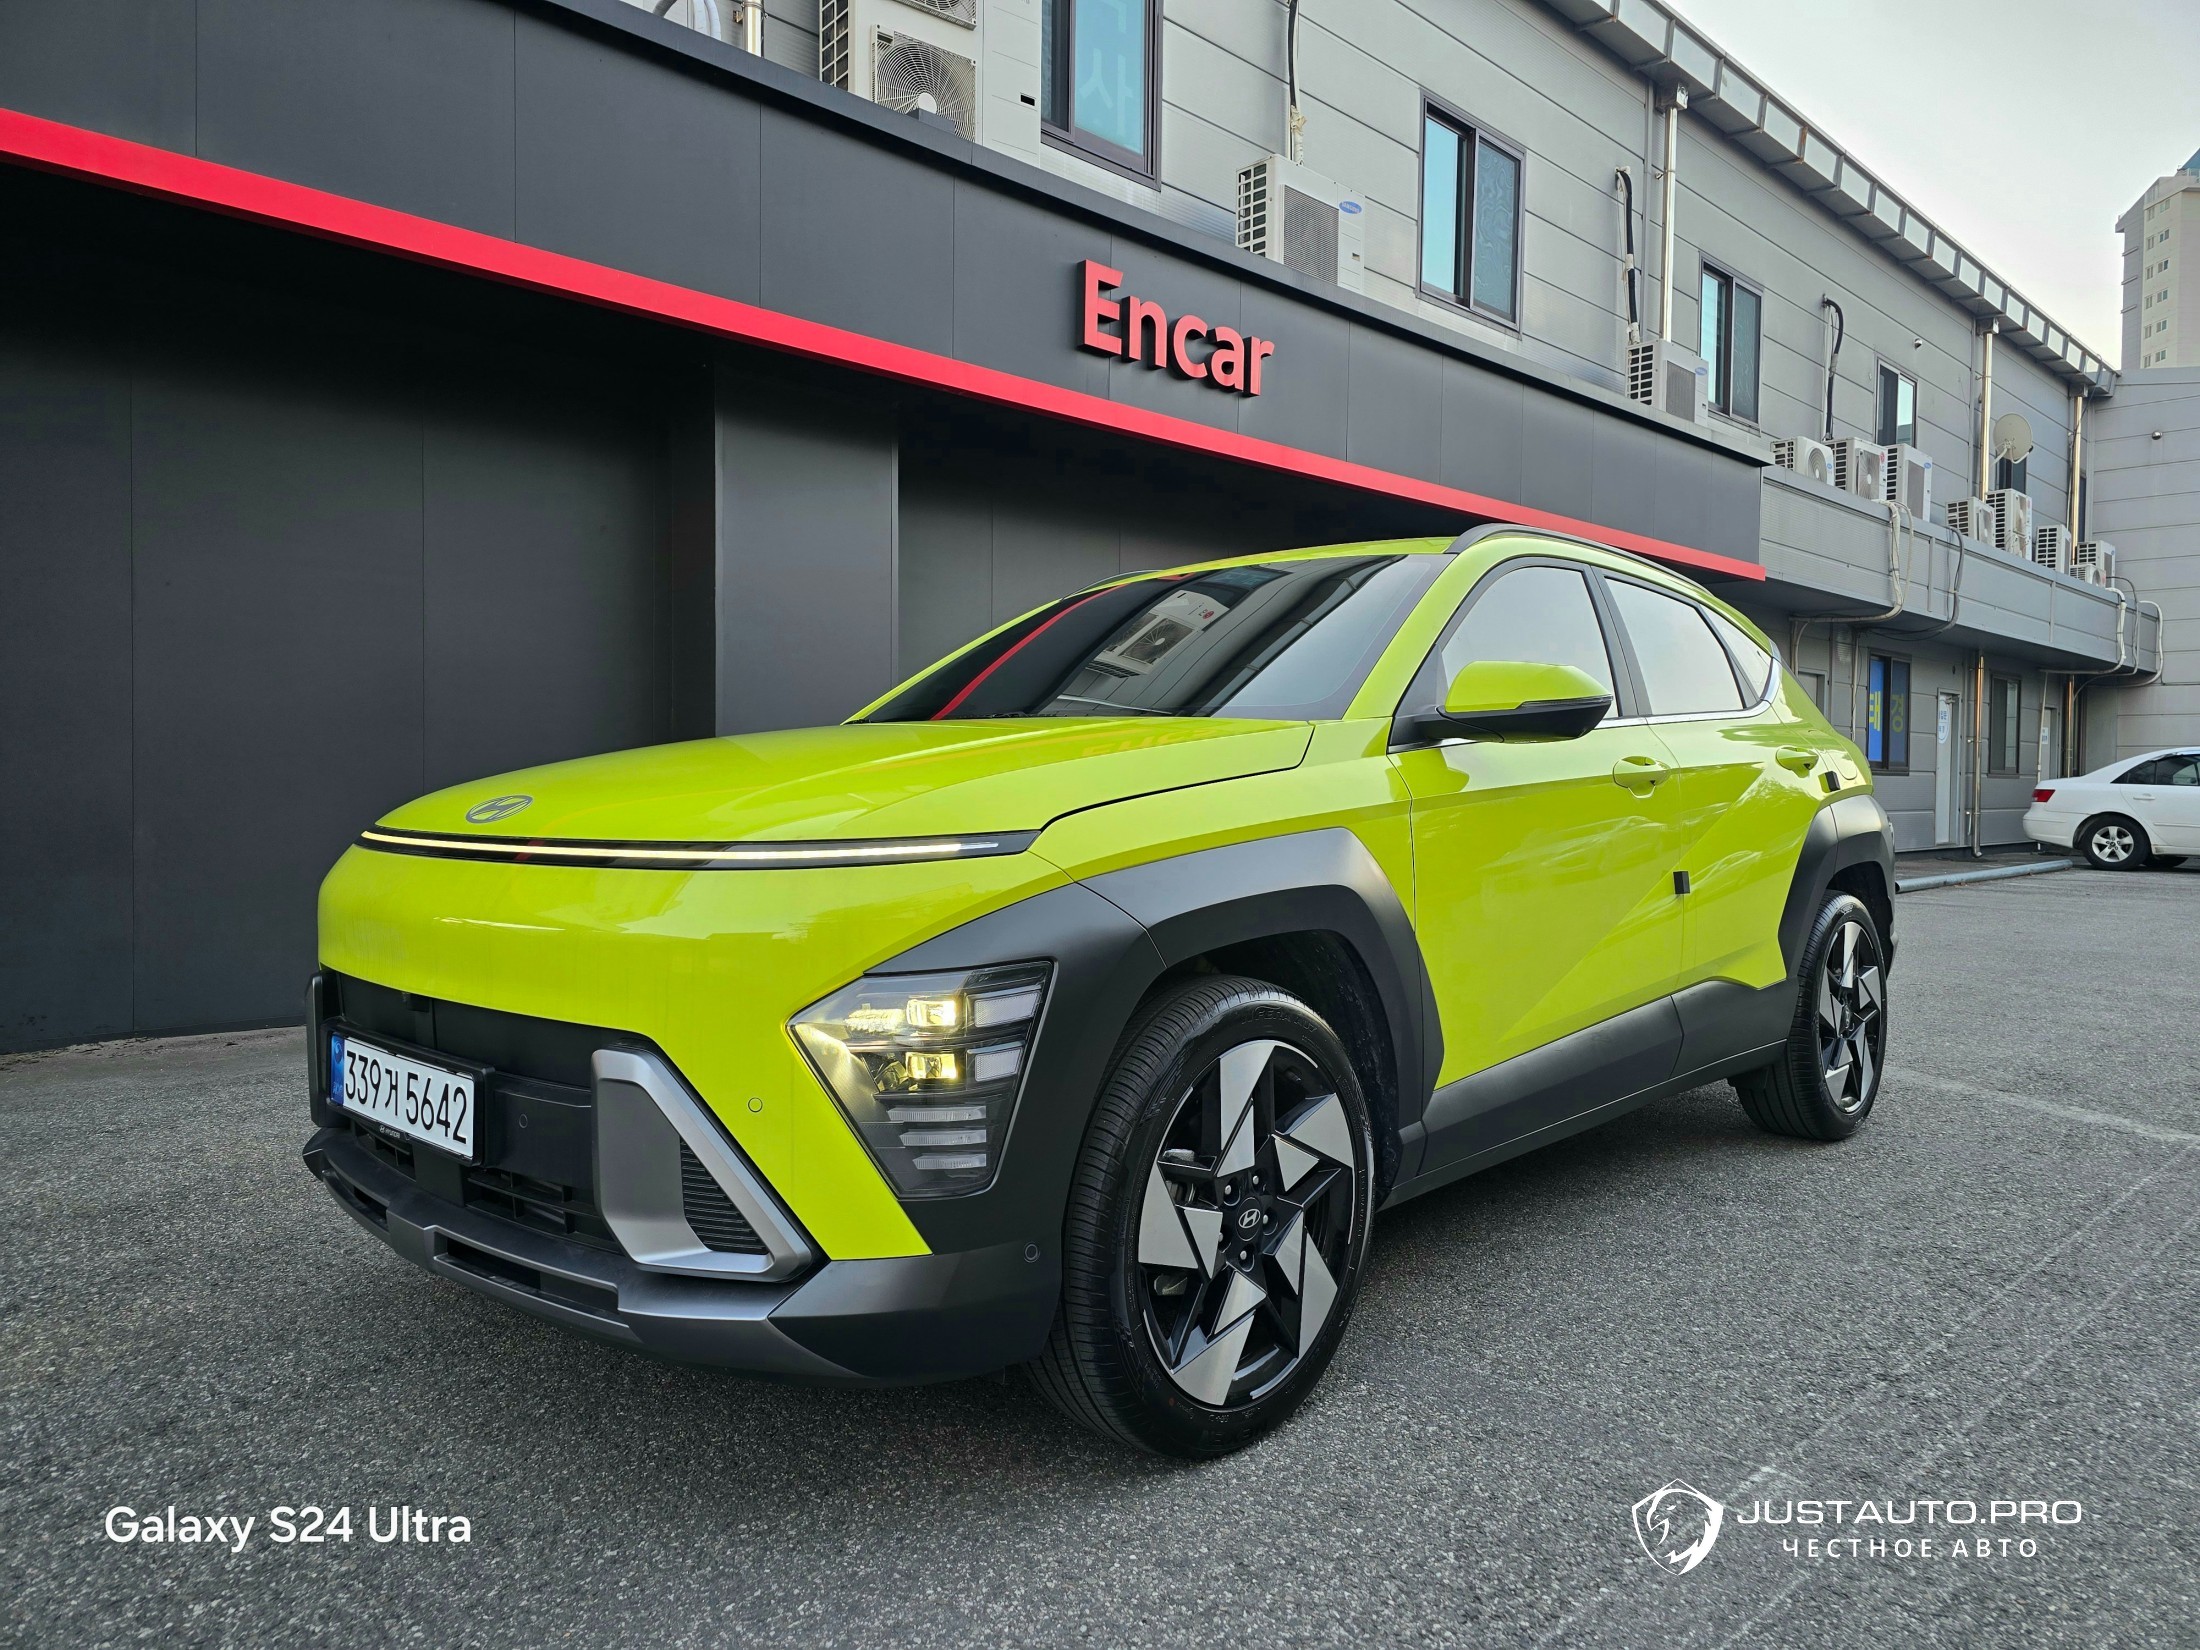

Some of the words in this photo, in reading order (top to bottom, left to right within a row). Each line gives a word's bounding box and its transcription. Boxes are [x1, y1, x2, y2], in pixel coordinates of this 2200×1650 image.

[1079, 258, 1275, 396] Encar
[345, 1049, 399, 1116] 339거
[406, 1071, 467, 1145] 5642
